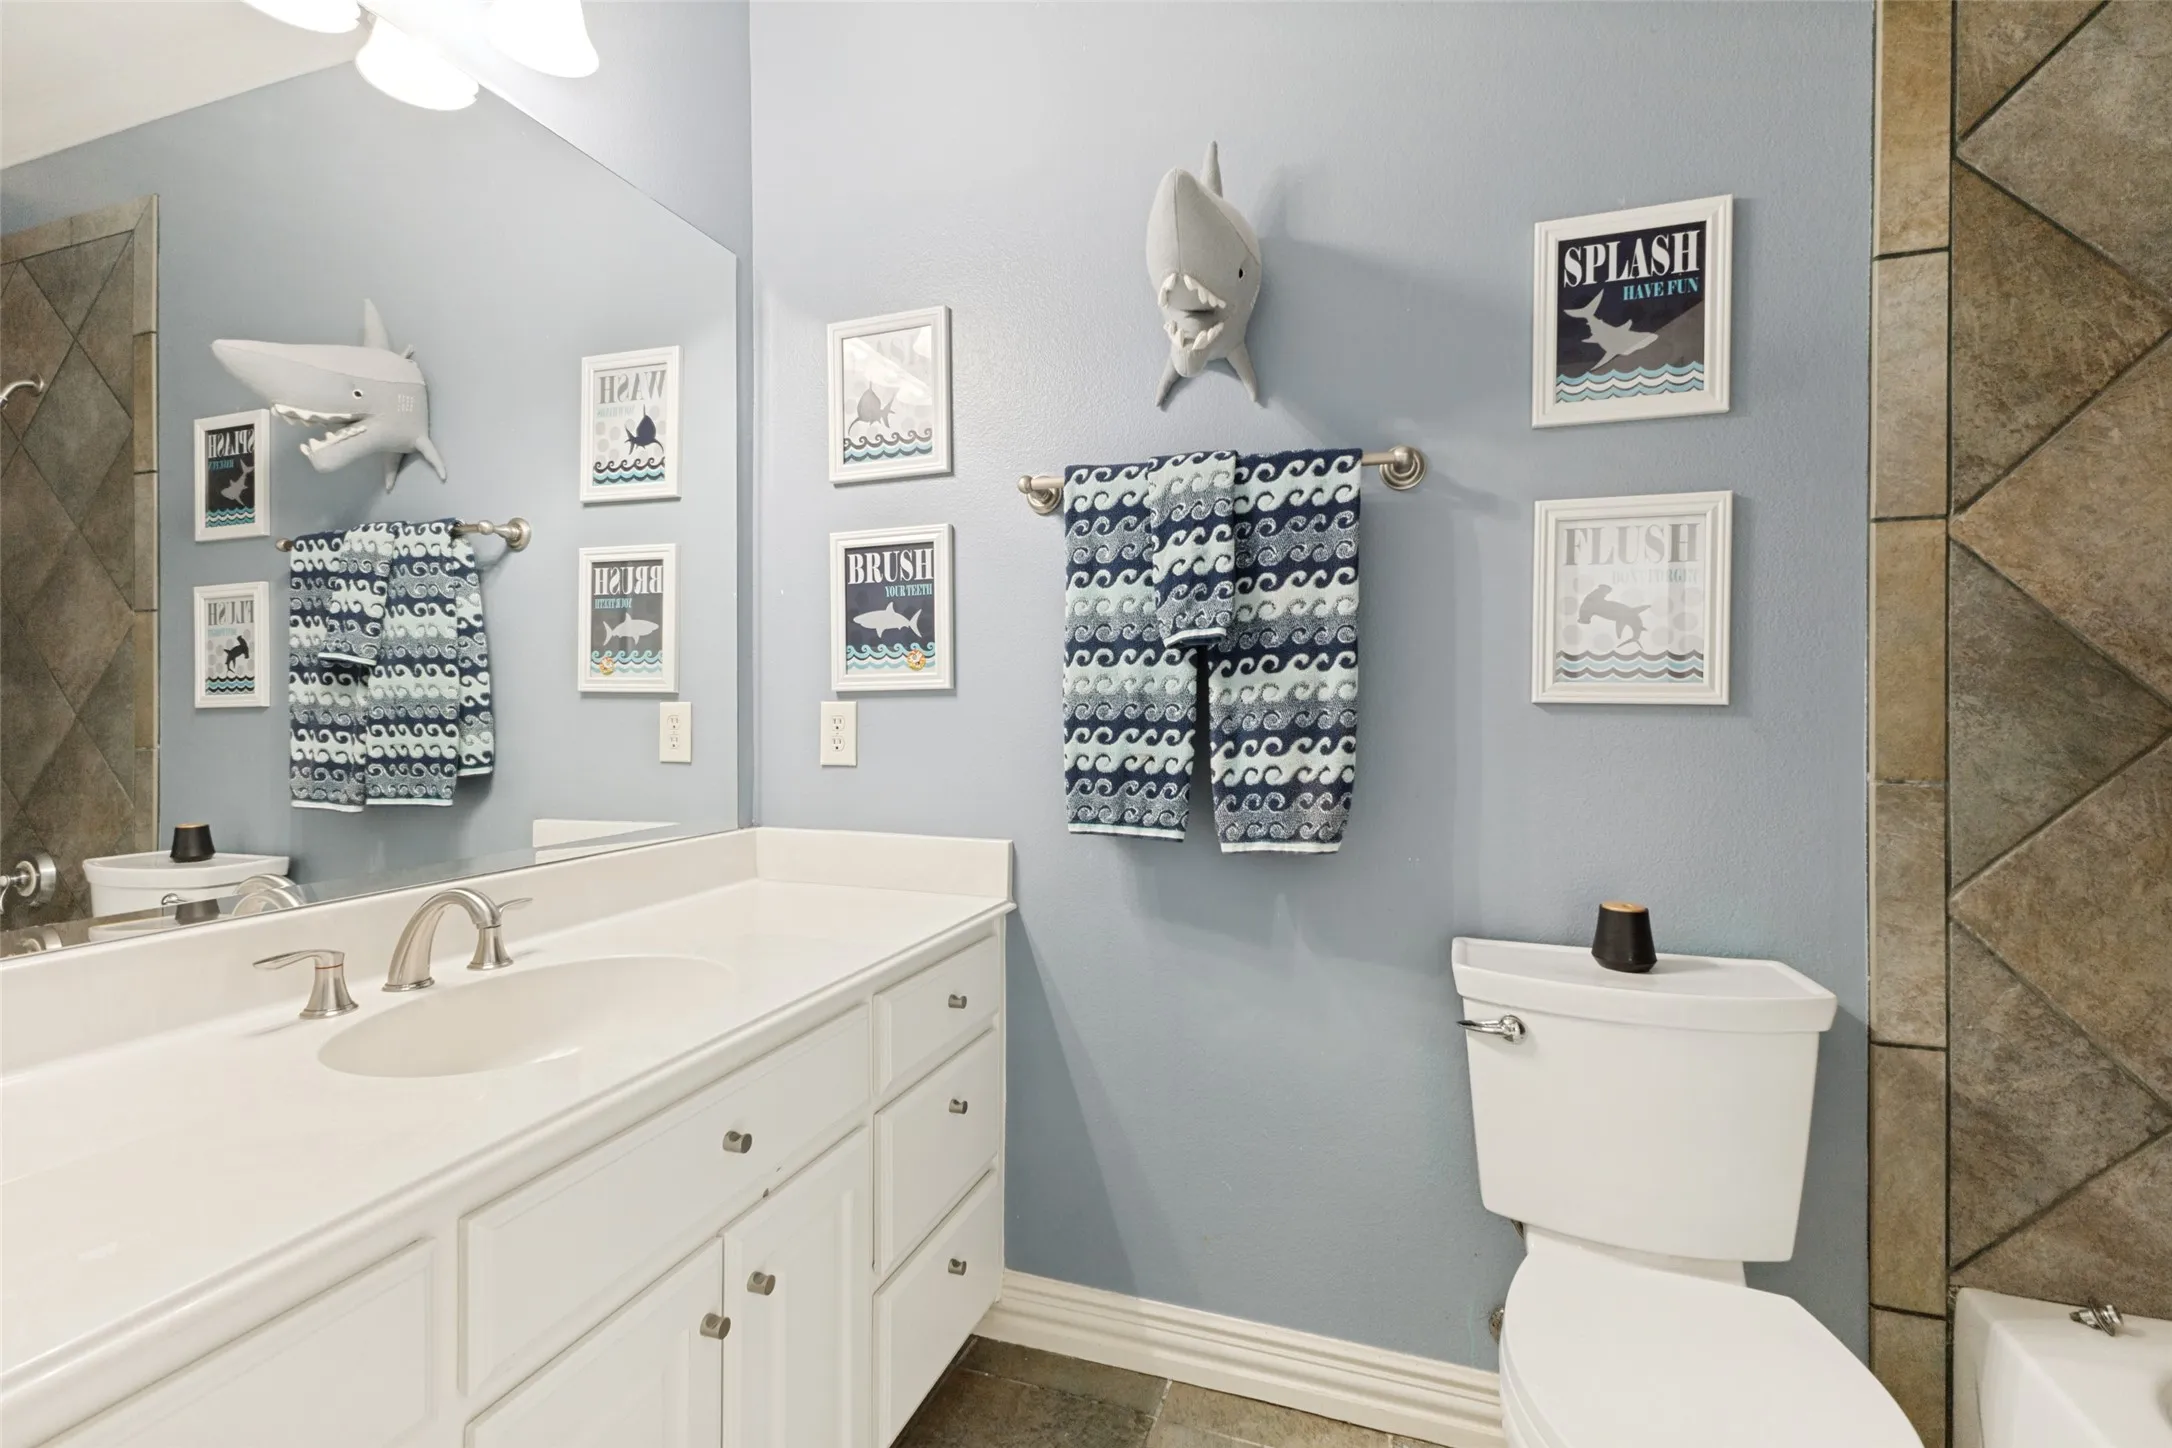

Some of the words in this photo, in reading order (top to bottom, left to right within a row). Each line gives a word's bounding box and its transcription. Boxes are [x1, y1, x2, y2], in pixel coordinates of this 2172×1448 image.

[1563, 229, 1701, 288] SPLASH
[1622, 281, 1664, 301] HAVE
[1667, 276, 1700, 296] FUN
[1564, 522, 1701, 566] FLUSH
[847, 548, 934, 585] BRUSH
[885, 584, 906, 598] YOUR
[906, 583, 933, 597] TEETH
